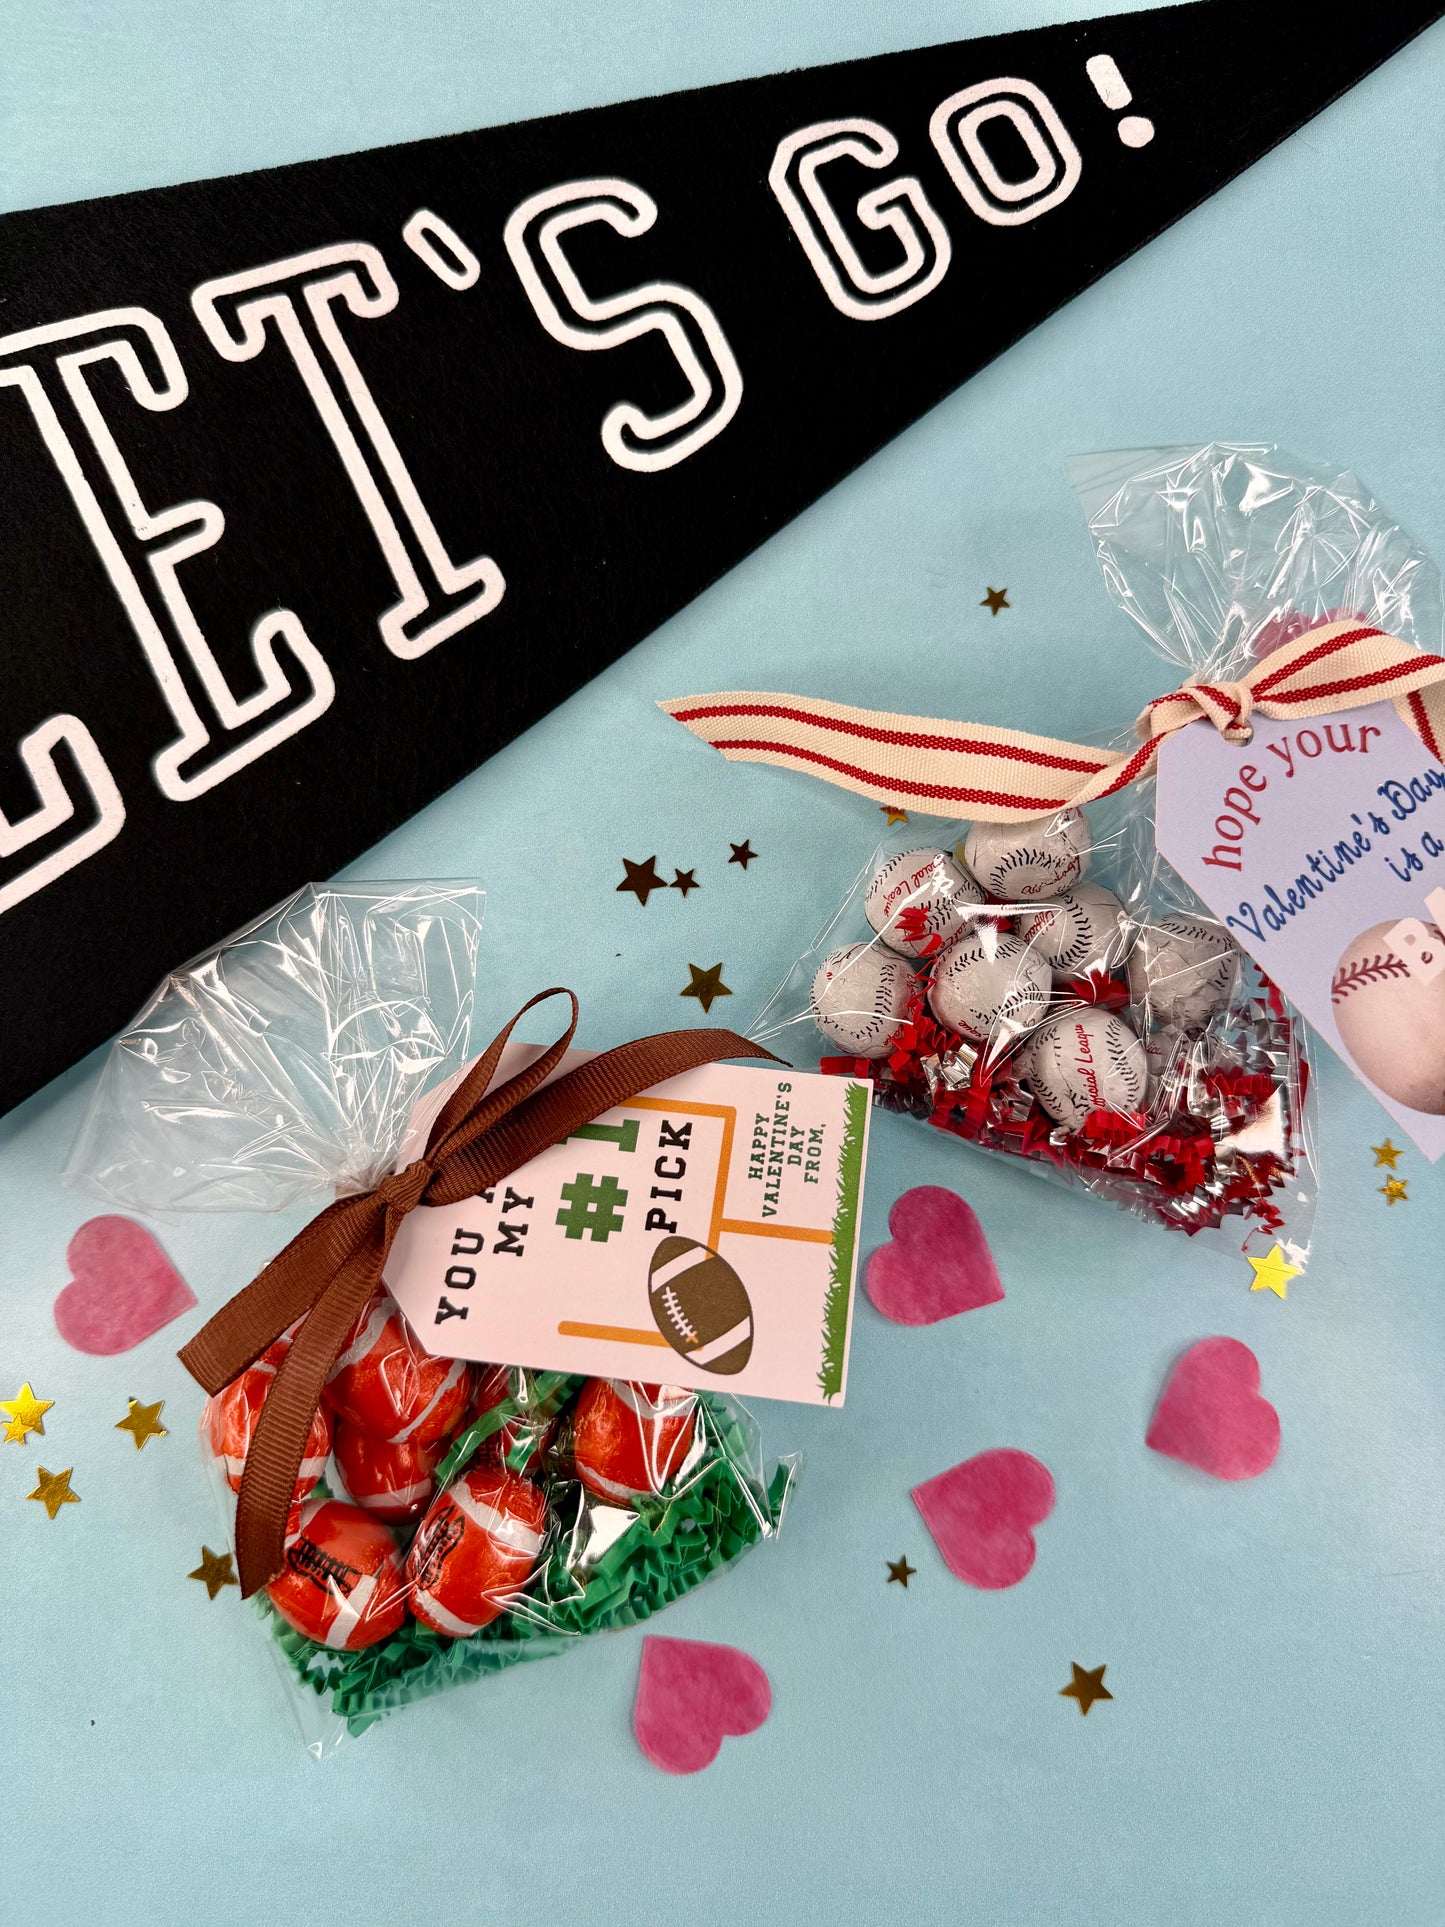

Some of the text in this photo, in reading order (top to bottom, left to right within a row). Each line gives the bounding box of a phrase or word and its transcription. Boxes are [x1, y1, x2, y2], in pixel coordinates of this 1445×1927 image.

[768, 54, 1155, 321] GO!
[1201, 723, 1381, 872] hope your
[1226, 812, 1391, 942] Valentine's
[1384, 831, 1444, 882] is a
[644, 1119, 693, 1234] PICK
[747, 1112, 770, 1180] HAPPY
[761, 1081, 793, 1218] VALENTINE'S
[786, 1125, 805, 1166] DAY
[803, 1123, 827, 1185] FROM,
[492, 1186, 535, 1257] MY
[434, 1227, 485, 1325] YOU
